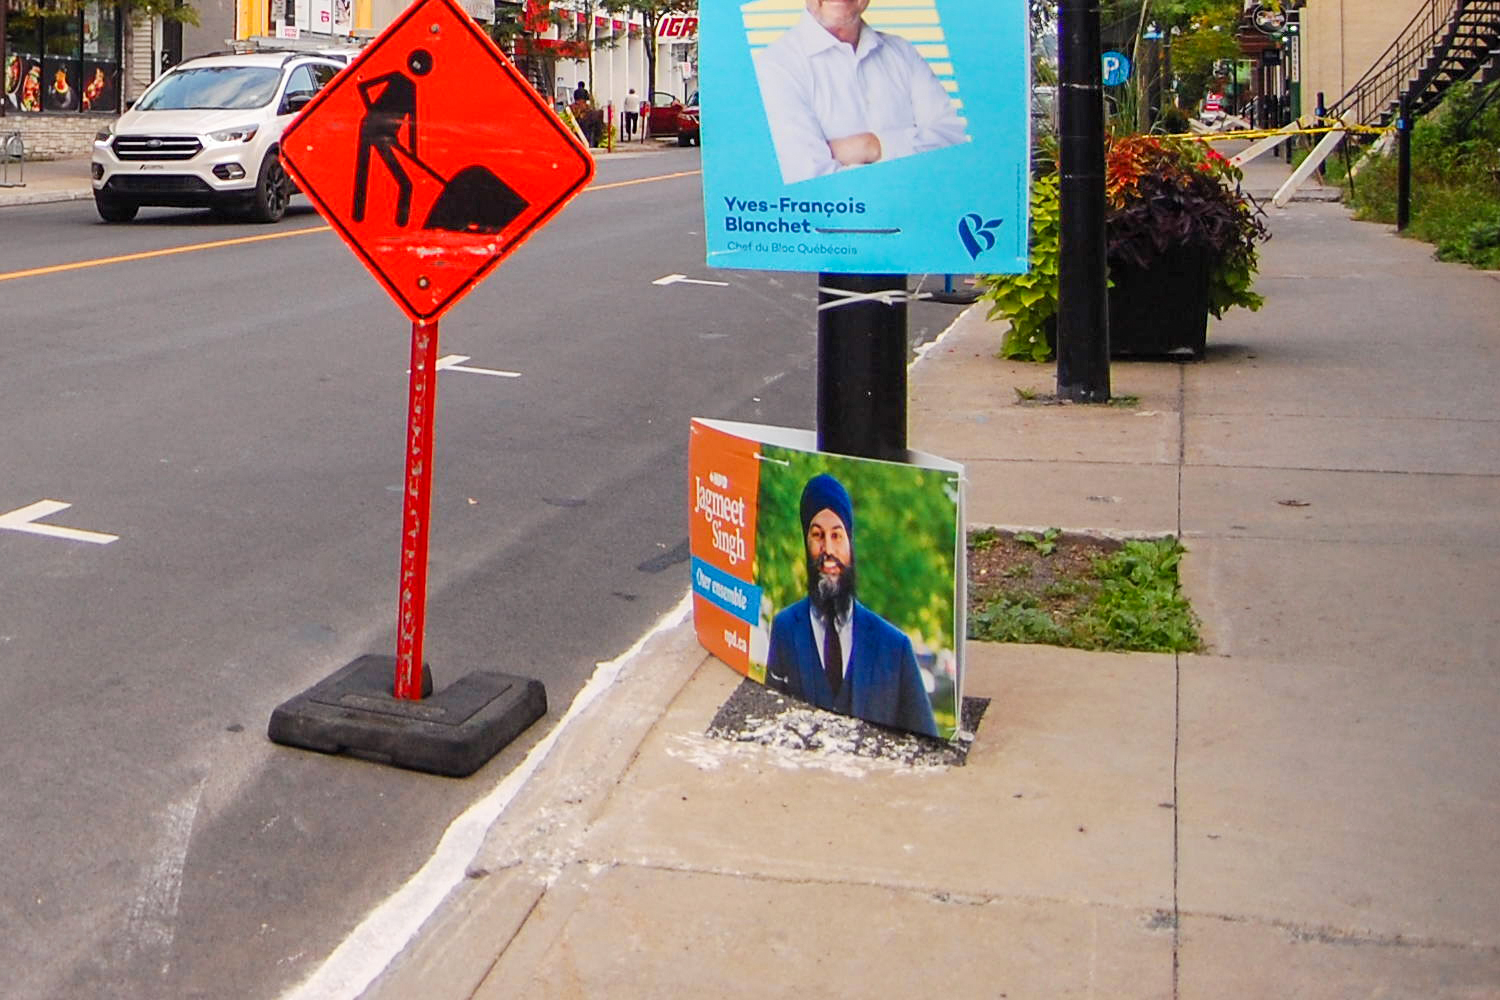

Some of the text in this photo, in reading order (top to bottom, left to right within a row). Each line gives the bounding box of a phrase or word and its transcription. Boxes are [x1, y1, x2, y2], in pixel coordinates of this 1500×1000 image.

[724, 196, 866, 218] Yves-François
[725, 216, 811, 234] Blanchet
[727, 240, 752, 252] Chef
[755, 241, 769, 253] du
[771, 242, 795, 253] Bloc
[695, 476, 745, 527] Jagmeet
[712, 520, 746, 565] Singh
[712, 580, 748, 610] ensemble
